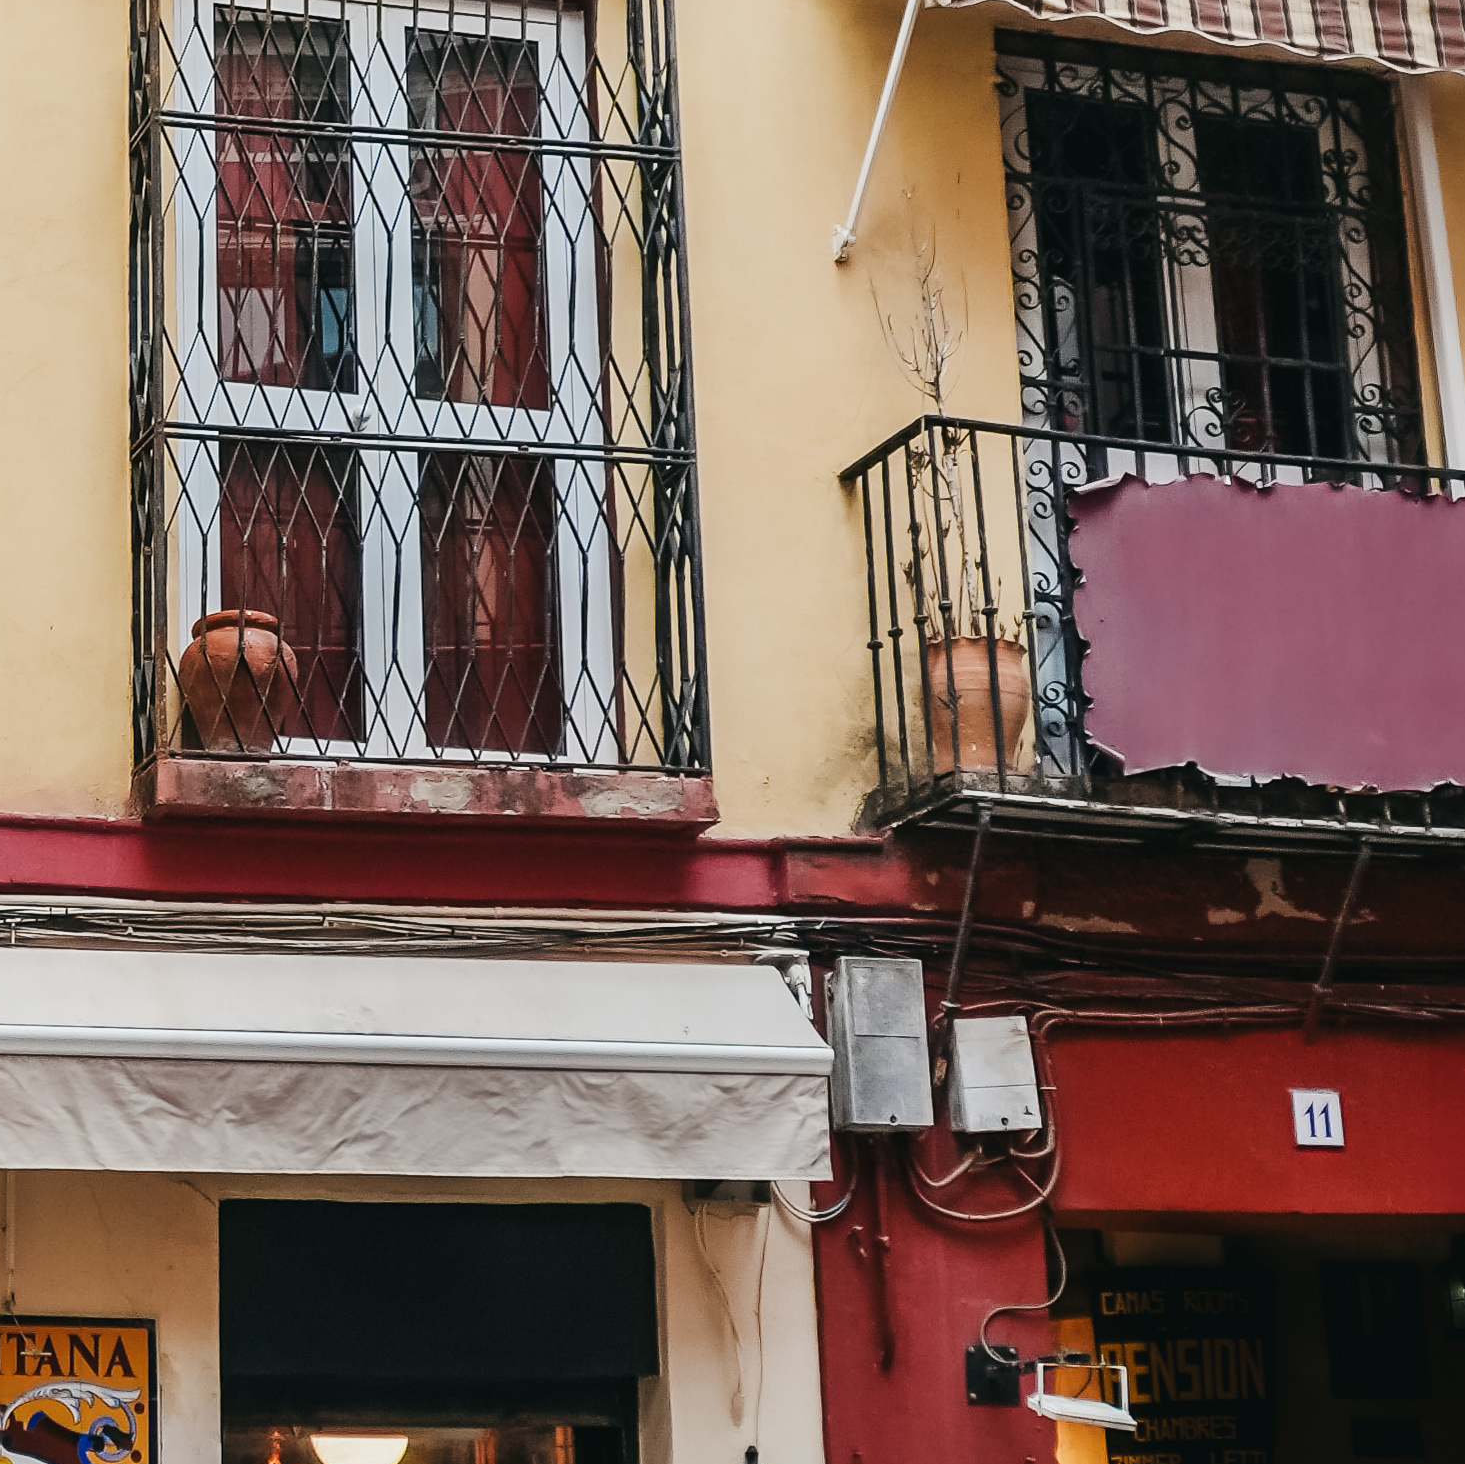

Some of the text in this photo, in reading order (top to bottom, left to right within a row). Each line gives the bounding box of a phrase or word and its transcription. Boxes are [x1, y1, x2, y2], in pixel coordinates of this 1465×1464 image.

[1303, 1101, 1333, 1139] 11
[1100, 1290, 1248, 1316] CAMAS ROOMS
[1099, 1337, 1267, 1404] PENSION
[1135, 1415, 1236, 1442] CHAMBRES
